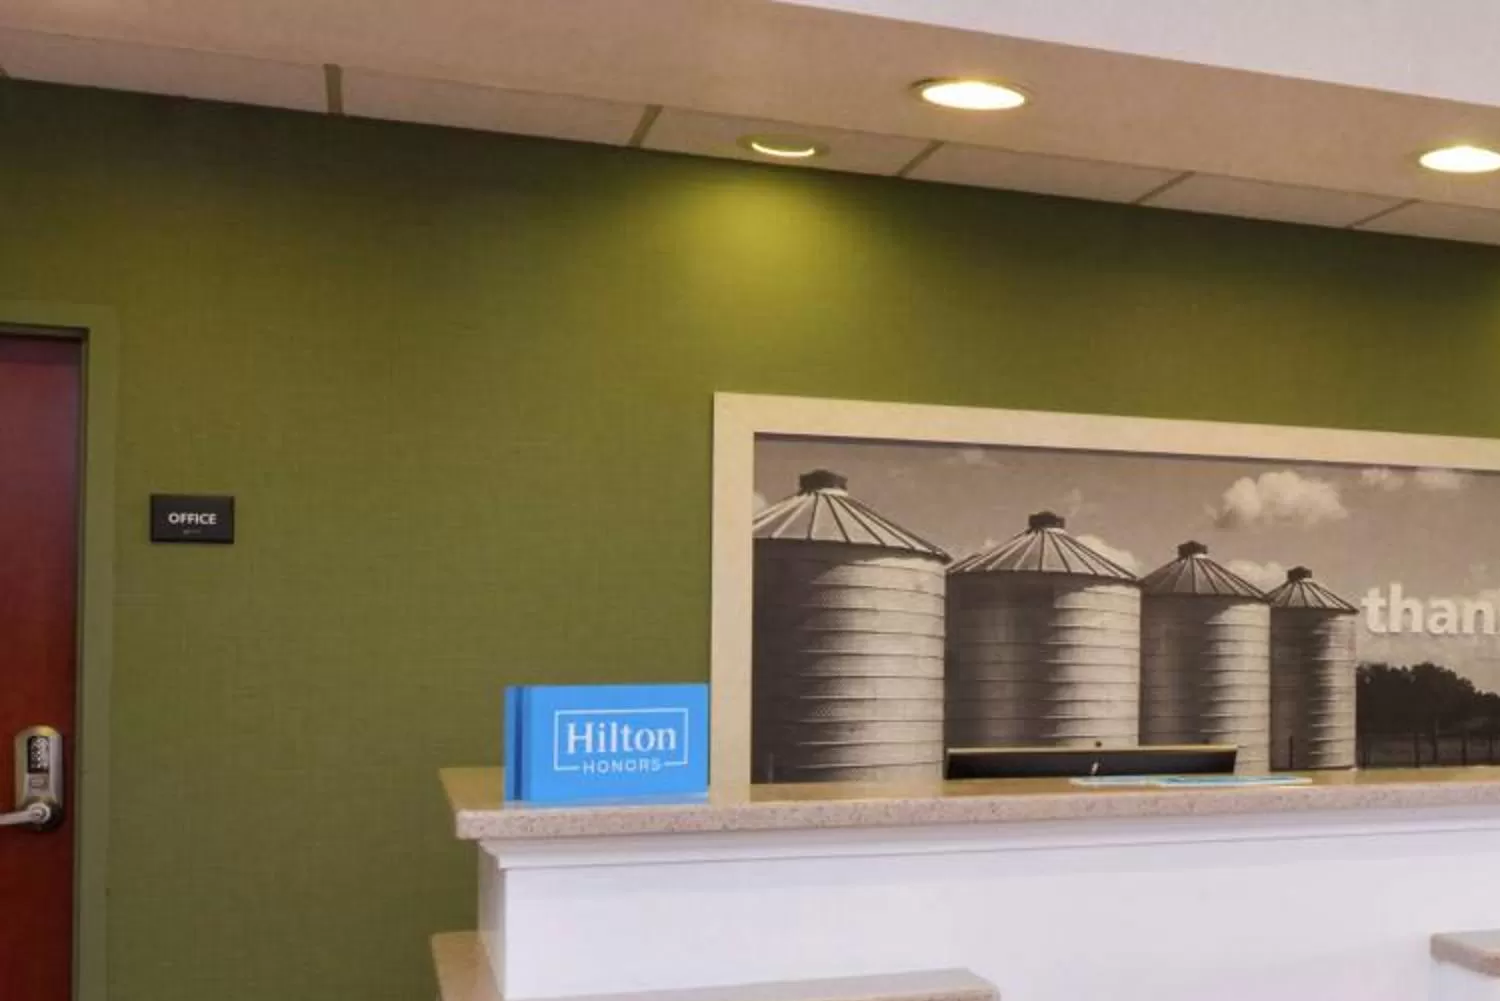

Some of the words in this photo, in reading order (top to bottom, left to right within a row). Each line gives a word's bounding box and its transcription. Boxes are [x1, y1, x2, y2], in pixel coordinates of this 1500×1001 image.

[168, 512, 217, 525] OFFICE
[567, 720, 677, 754] Hilton
[583, 758, 661, 774] HONORS
